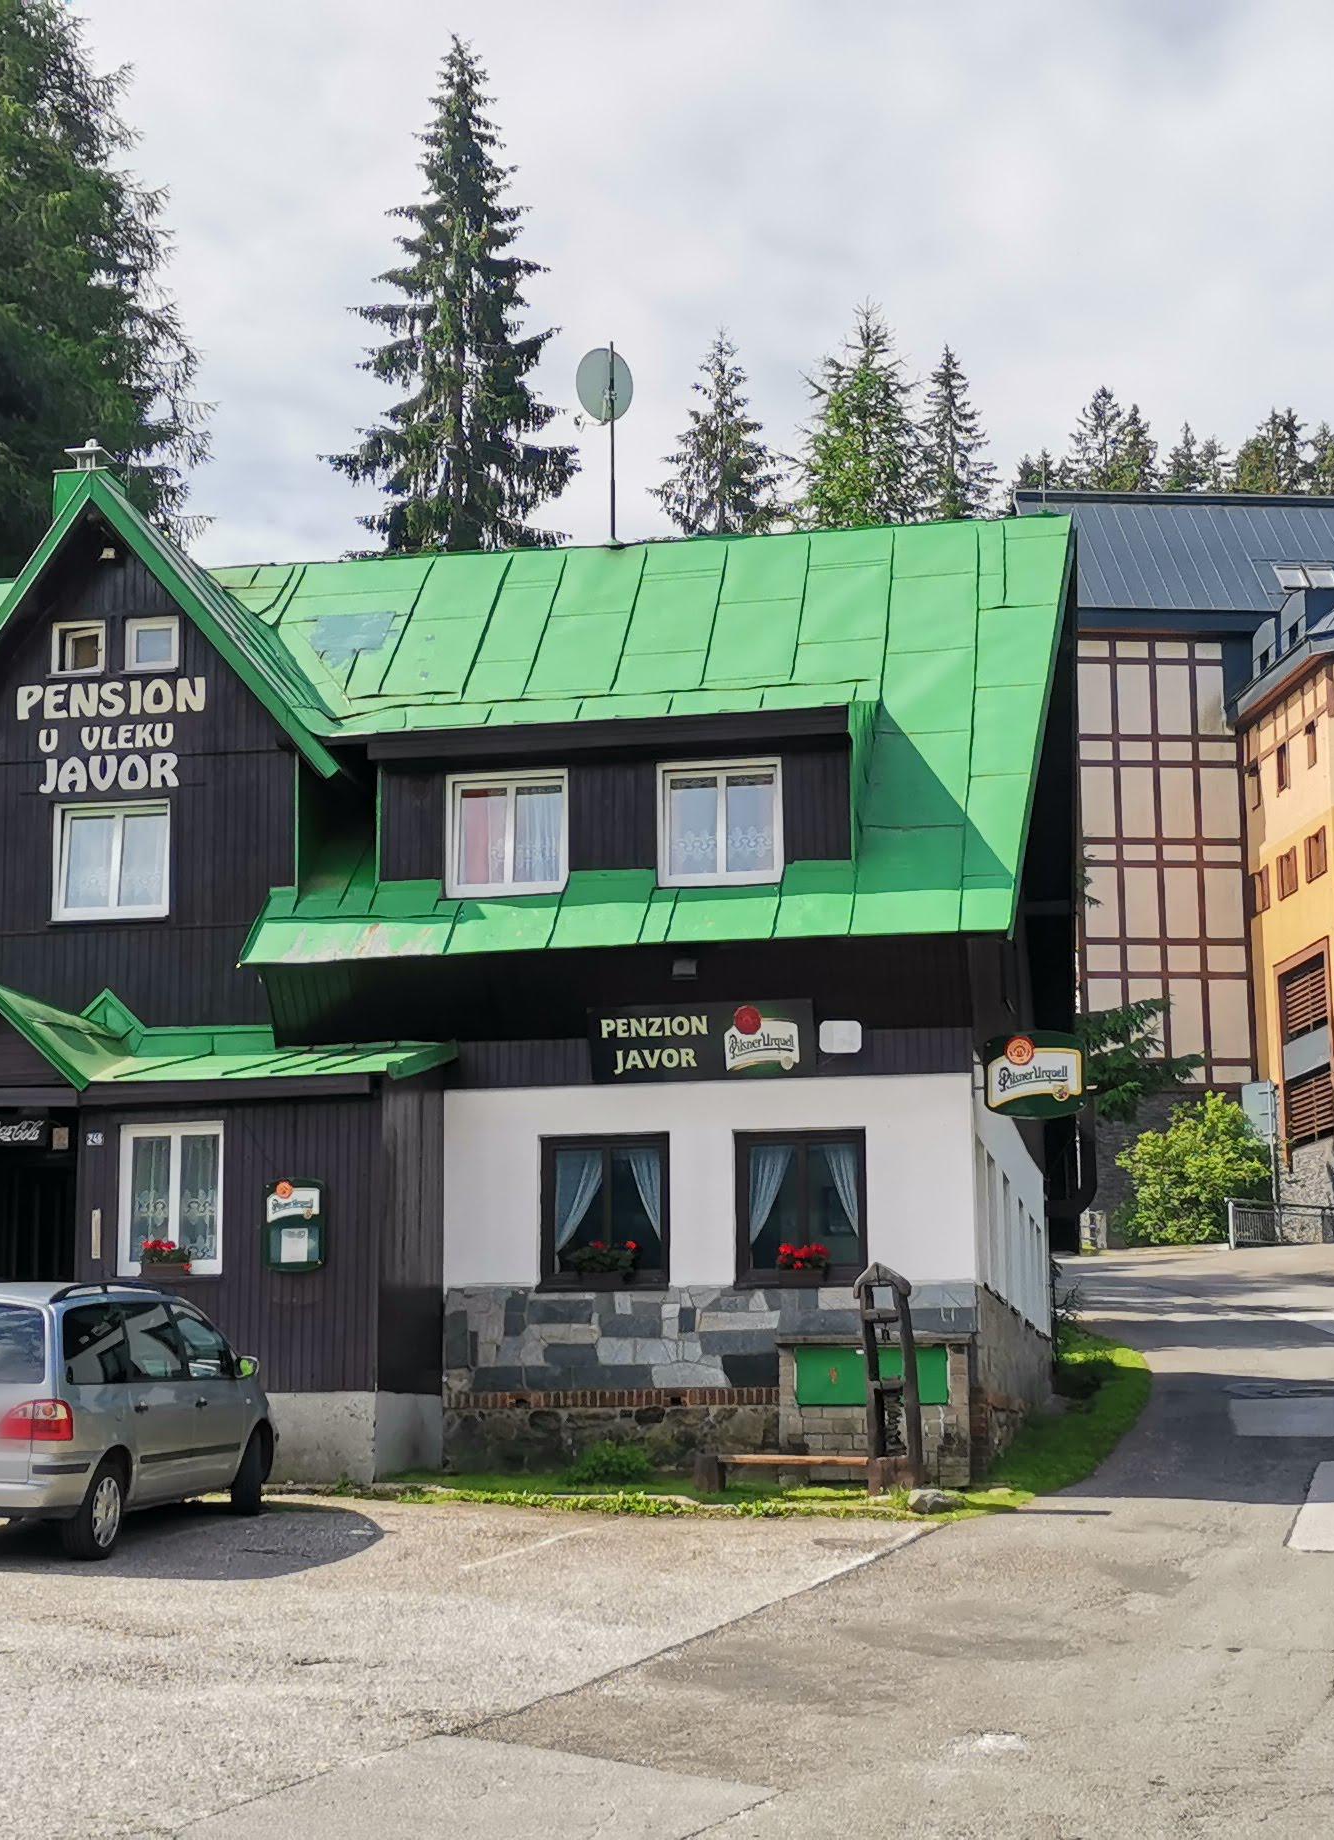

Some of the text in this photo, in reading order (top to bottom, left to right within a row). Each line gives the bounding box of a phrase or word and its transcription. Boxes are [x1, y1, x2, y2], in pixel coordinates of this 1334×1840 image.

[17, 677, 206, 720] PENSION
[38, 722, 174, 752] U VLEKU
[38, 752, 180, 794] JAVOR
[600, 1015, 708, 1038] PENZION
[614, 1048, 697, 1075] JAVOR
